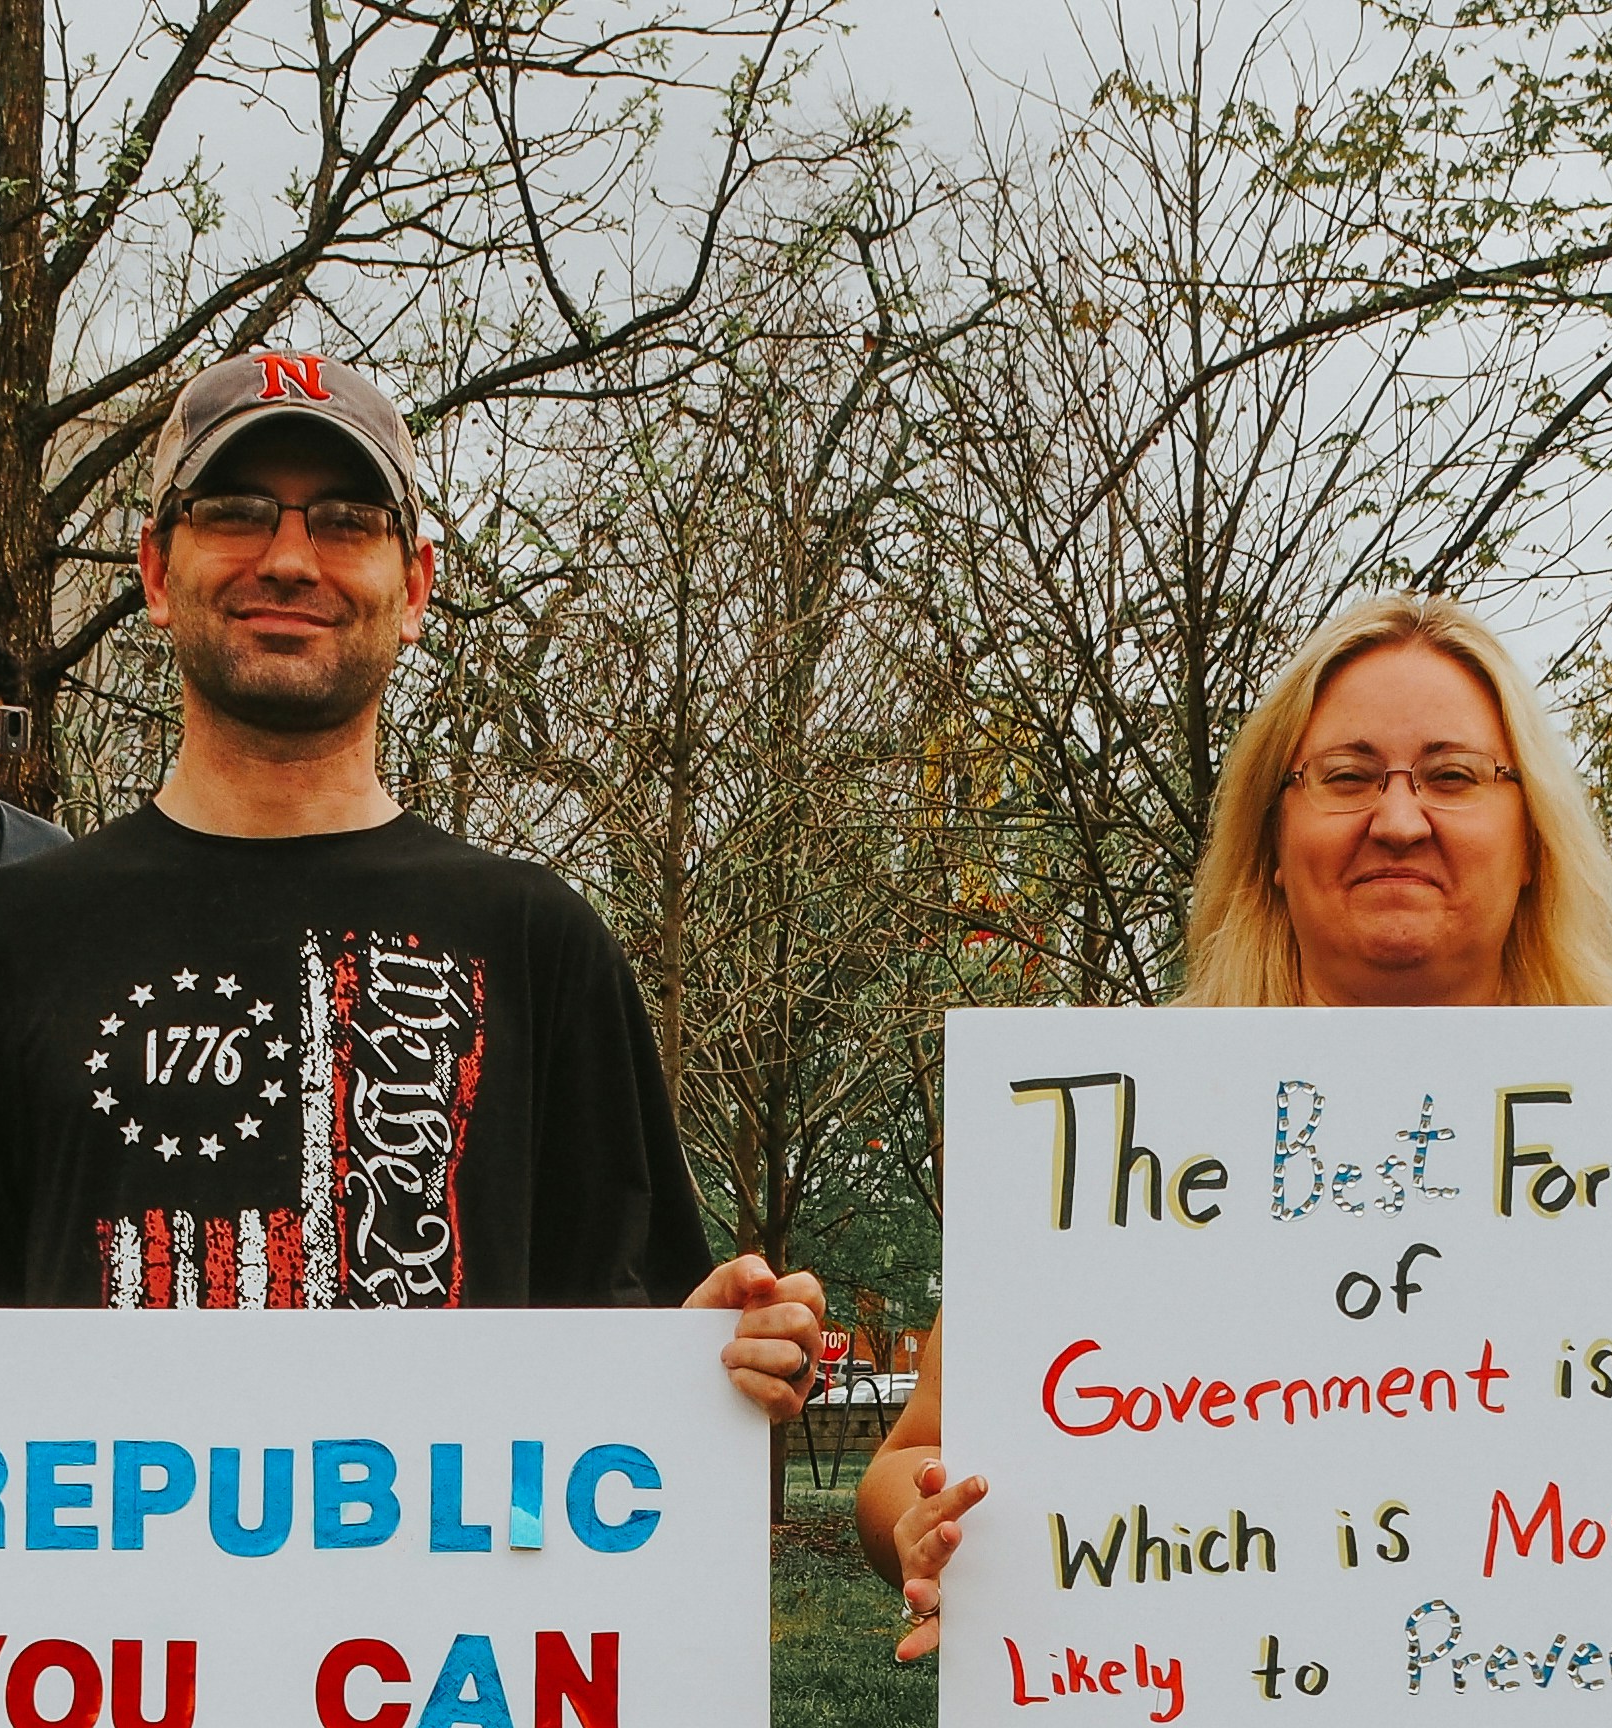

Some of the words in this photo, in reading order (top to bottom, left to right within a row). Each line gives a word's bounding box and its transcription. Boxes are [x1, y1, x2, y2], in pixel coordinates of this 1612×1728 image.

[252, 353, 334, 402] N
[145, 1025, 251, 1086] 1776
[1010, 1073, 1228, 1230] The
[1272, 1080, 1458, 1222] Best
[1336, 1243, 1442, 1320] of
[820, 1331, 846, 1349] TOP
[1042, 1339, 1509, 1437] Government
[1048, 1503, 1277, 1590] Which
[1338, 1500, 1410, 1568] is
[1004, 1636, 1185, 1723] Likely
[1251, 1634, 1329, 1700] to
